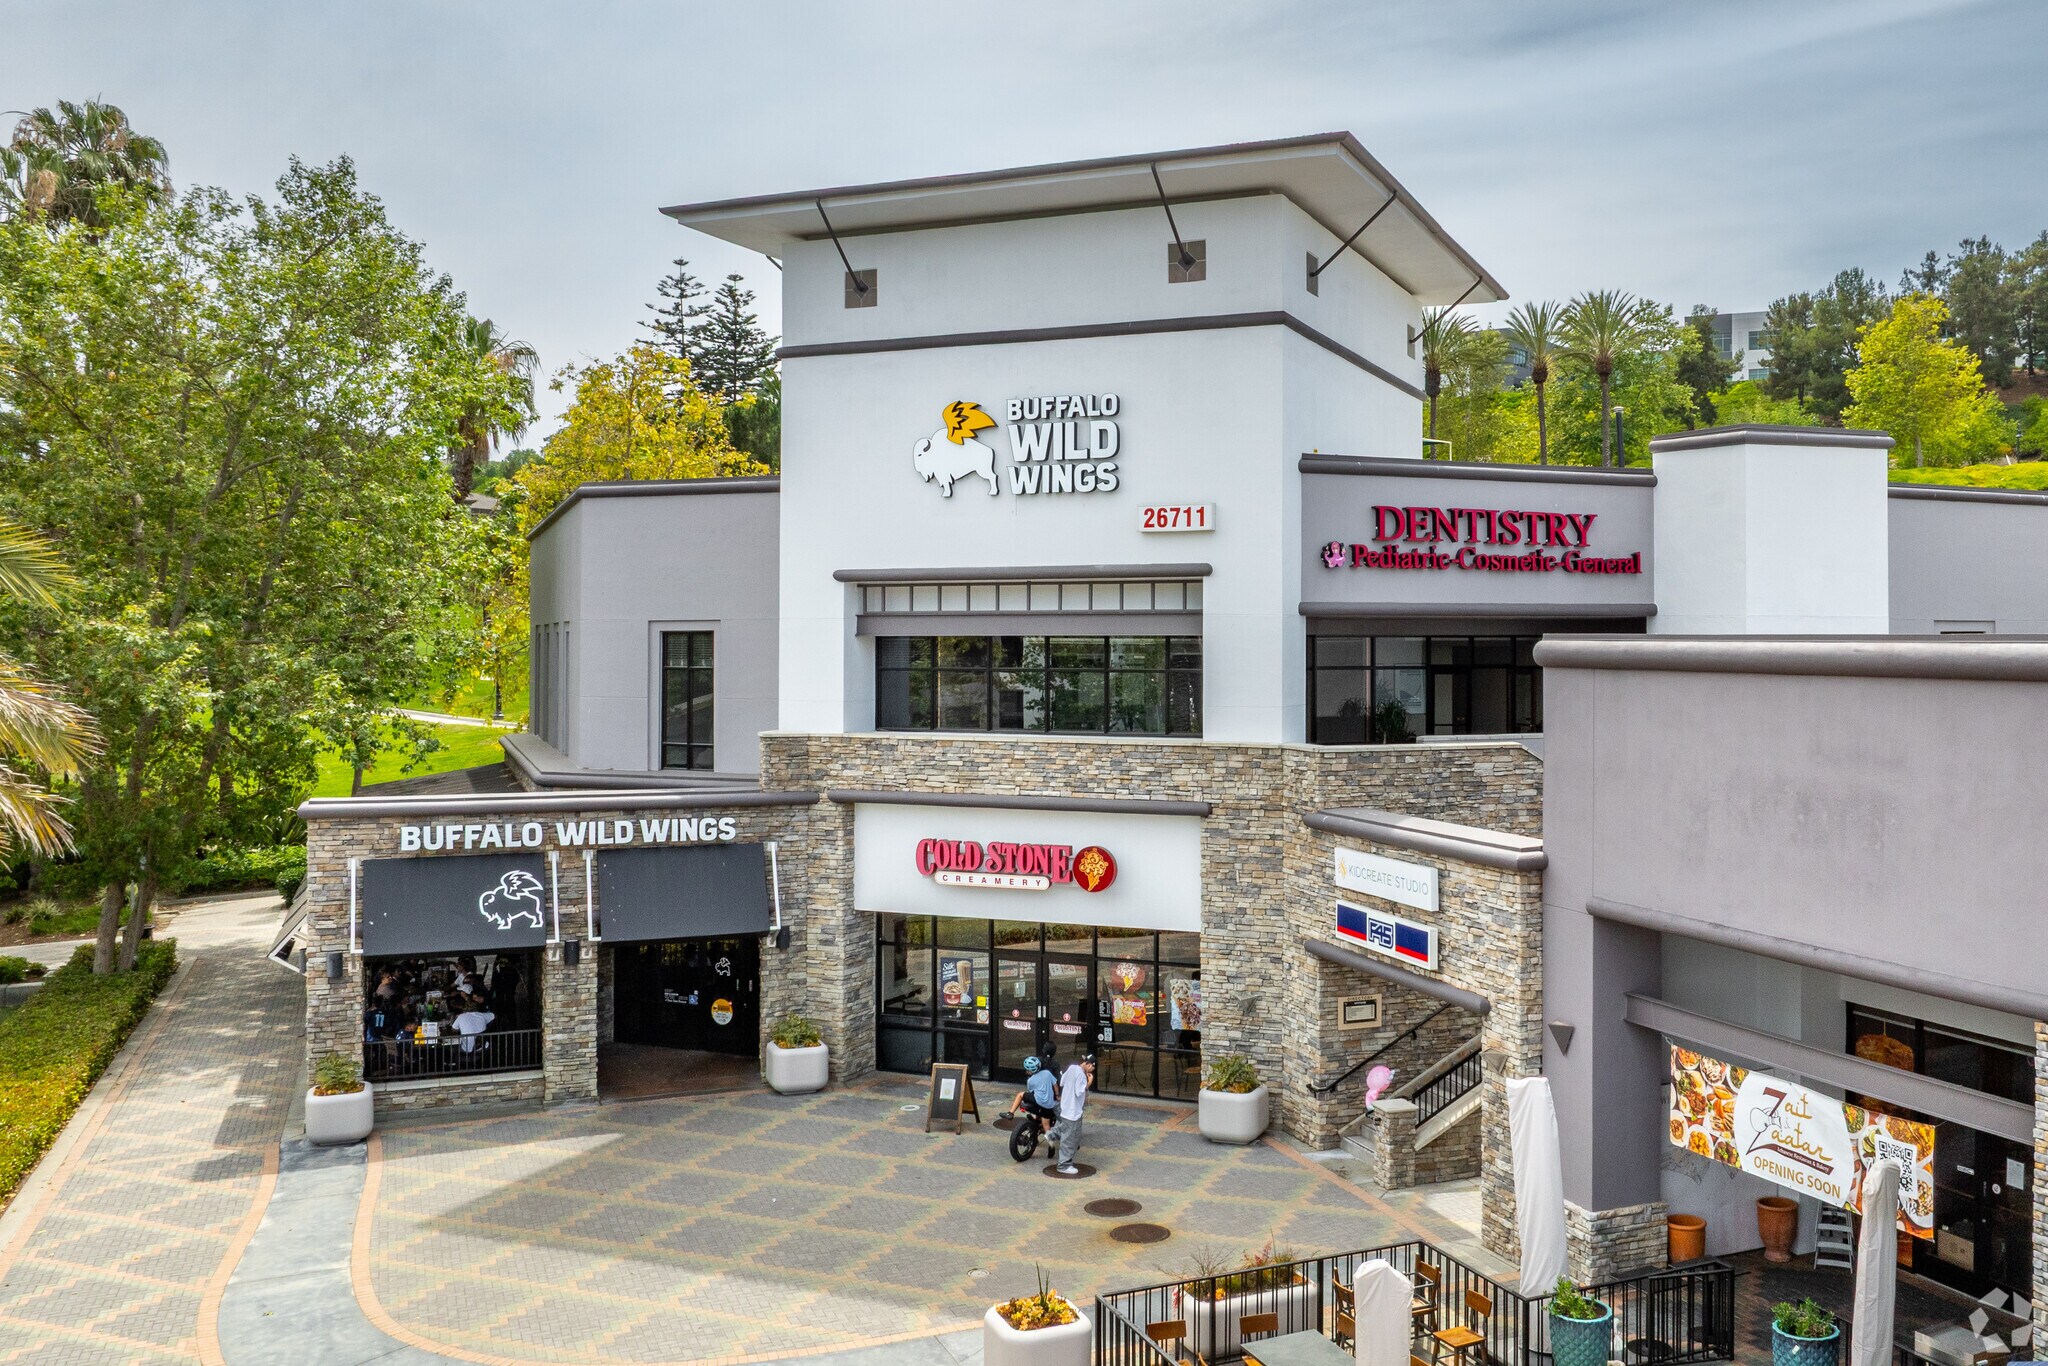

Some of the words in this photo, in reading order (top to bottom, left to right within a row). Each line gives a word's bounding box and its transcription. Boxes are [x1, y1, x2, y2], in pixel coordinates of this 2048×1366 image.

[1007, 393, 1120, 421] BUFFALO
[1007, 420, 1120, 462] WILD
[1007, 462, 1120, 495] WINGS
[1143, 506, 1205, 528] 26711
[1371, 505, 1598, 547] DENTISTRY
[400, 822, 543, 851] BUFFALO
[556, 820, 634, 846] WILD
[639, 817, 736, 842] WINGS
[915, 838, 984, 876] COLD
[984, 841, 1074, 884] STONE
[942, 874, 1042, 887] CREAMERY
[1395, 875, 1429, 896] STUDIO
[1368, 917, 1394, 949] F45
[1754, 1156, 1804, 1184] OPENING
[1807, 1175, 1841, 1198] SOON
